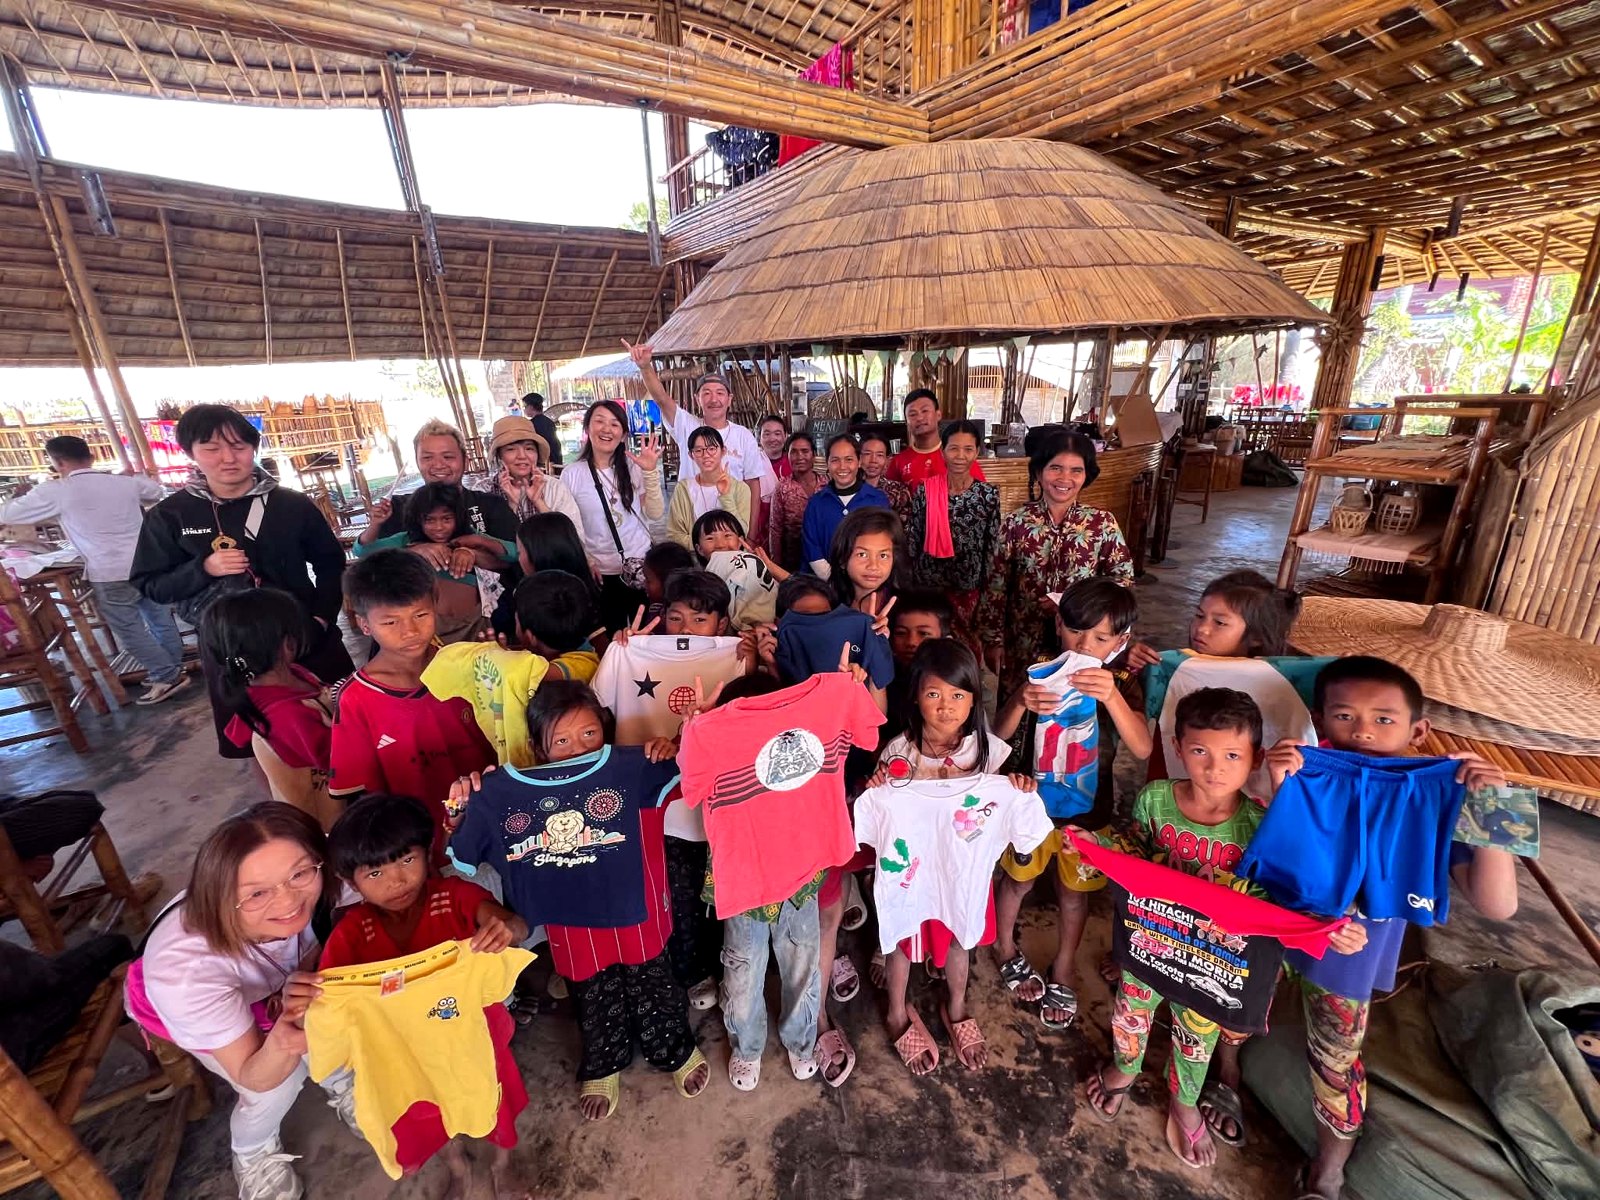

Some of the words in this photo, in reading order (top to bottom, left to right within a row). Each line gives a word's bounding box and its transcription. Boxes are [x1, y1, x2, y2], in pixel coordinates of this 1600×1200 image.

[533, 853, 598, 868] Singapore
[1127, 904, 1174, 929] WELCOME
[1177, 921, 1189, 935] TO
[1149, 899, 1194, 924] HITACHI
[1138, 917, 1156, 930] THE
[1158, 923, 1191, 944] WORLD
[1194, 939, 1206, 948] OF
[1209, 945, 1248, 968] TOMICA
[1149, 931, 1168, 942] WITH
[1172, 940, 1211, 960] TIMELESS
[1131, 944, 1147, 958] 110
[1149, 955, 1184, 978] Toyota
[1175, 949, 1187, 959] 41
[1192, 955, 1244, 985] MORITA
[382, 977, 400, 994] ME
